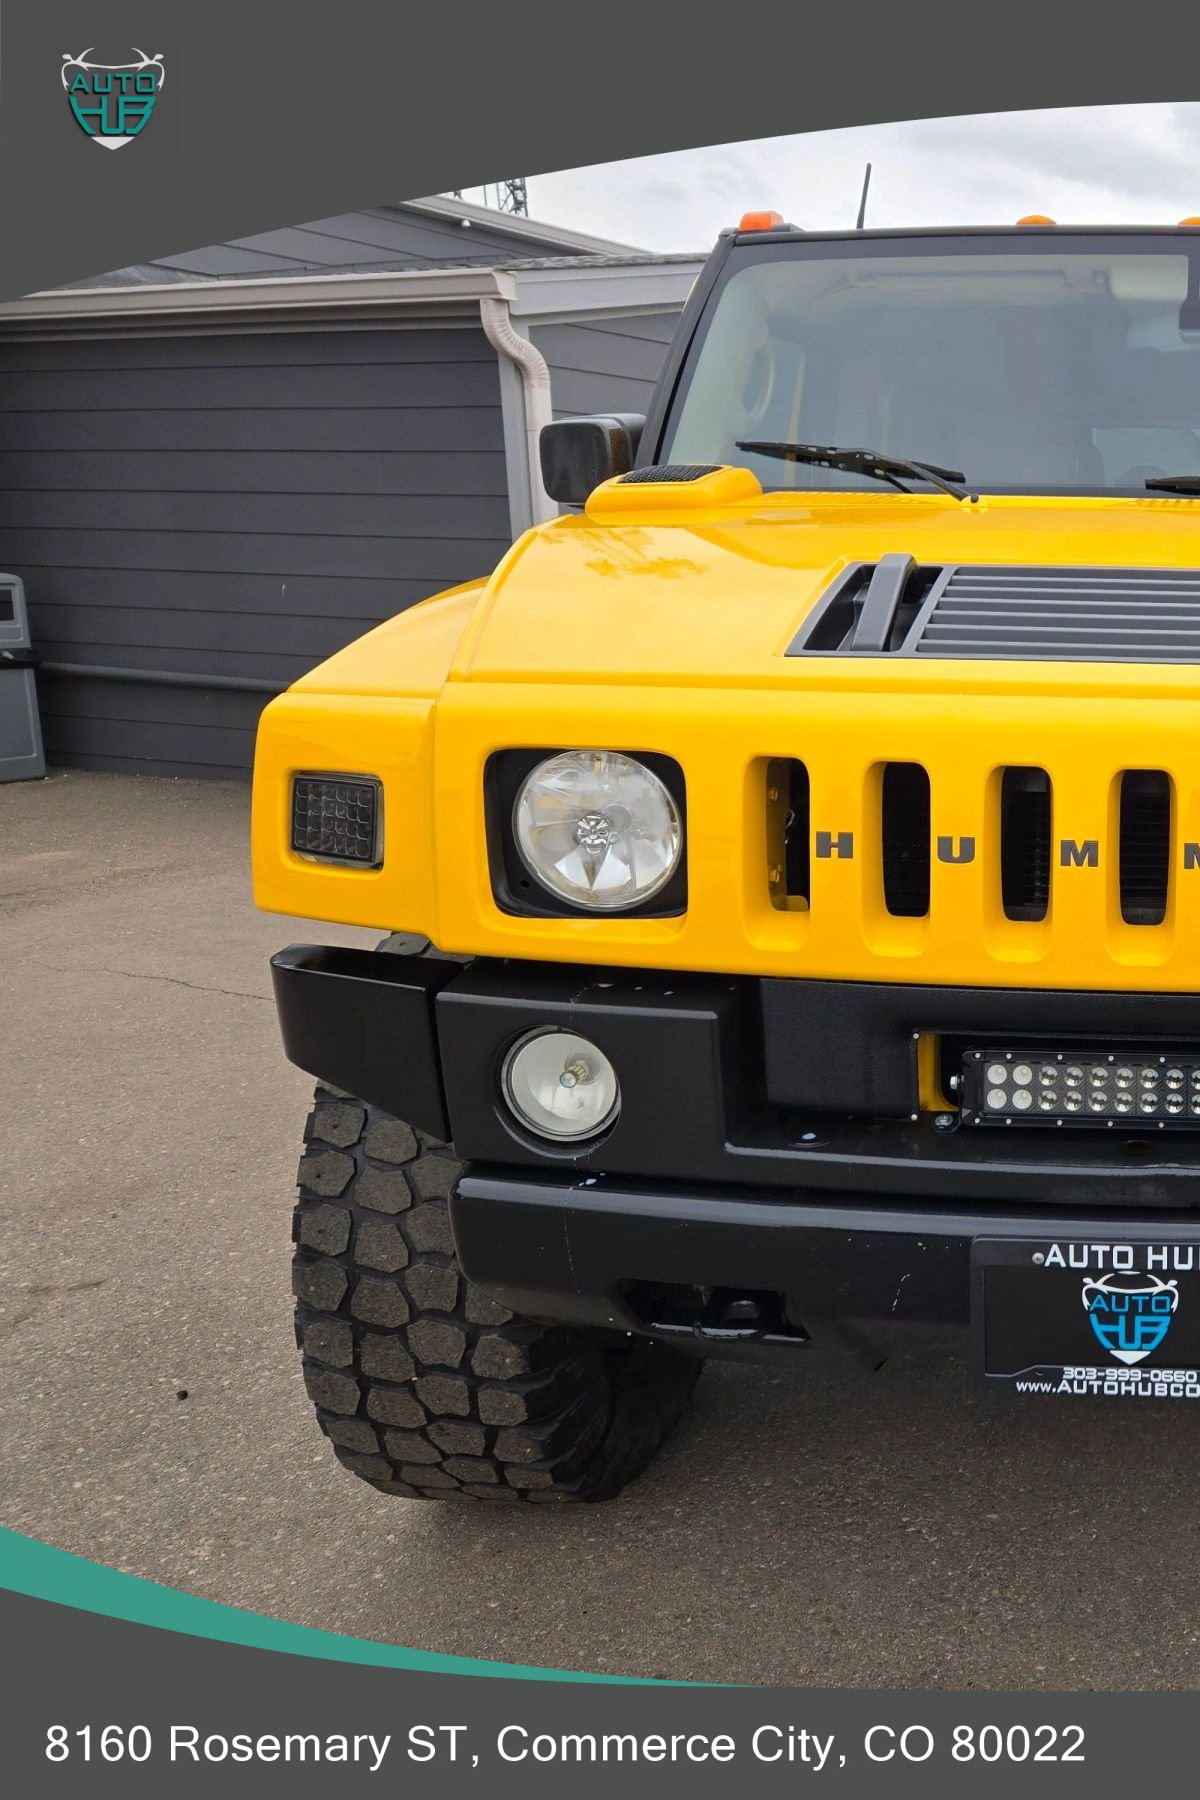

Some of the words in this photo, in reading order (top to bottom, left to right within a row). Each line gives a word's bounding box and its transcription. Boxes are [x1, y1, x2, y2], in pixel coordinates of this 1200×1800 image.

[1044, 1244, 1134, 1269] AUTO
[1089, 1295, 1170, 1313] AUTO
[1090, 1314, 1171, 1350] HUB
[1062, 1366, 1198, 1384] 303-999-0660
